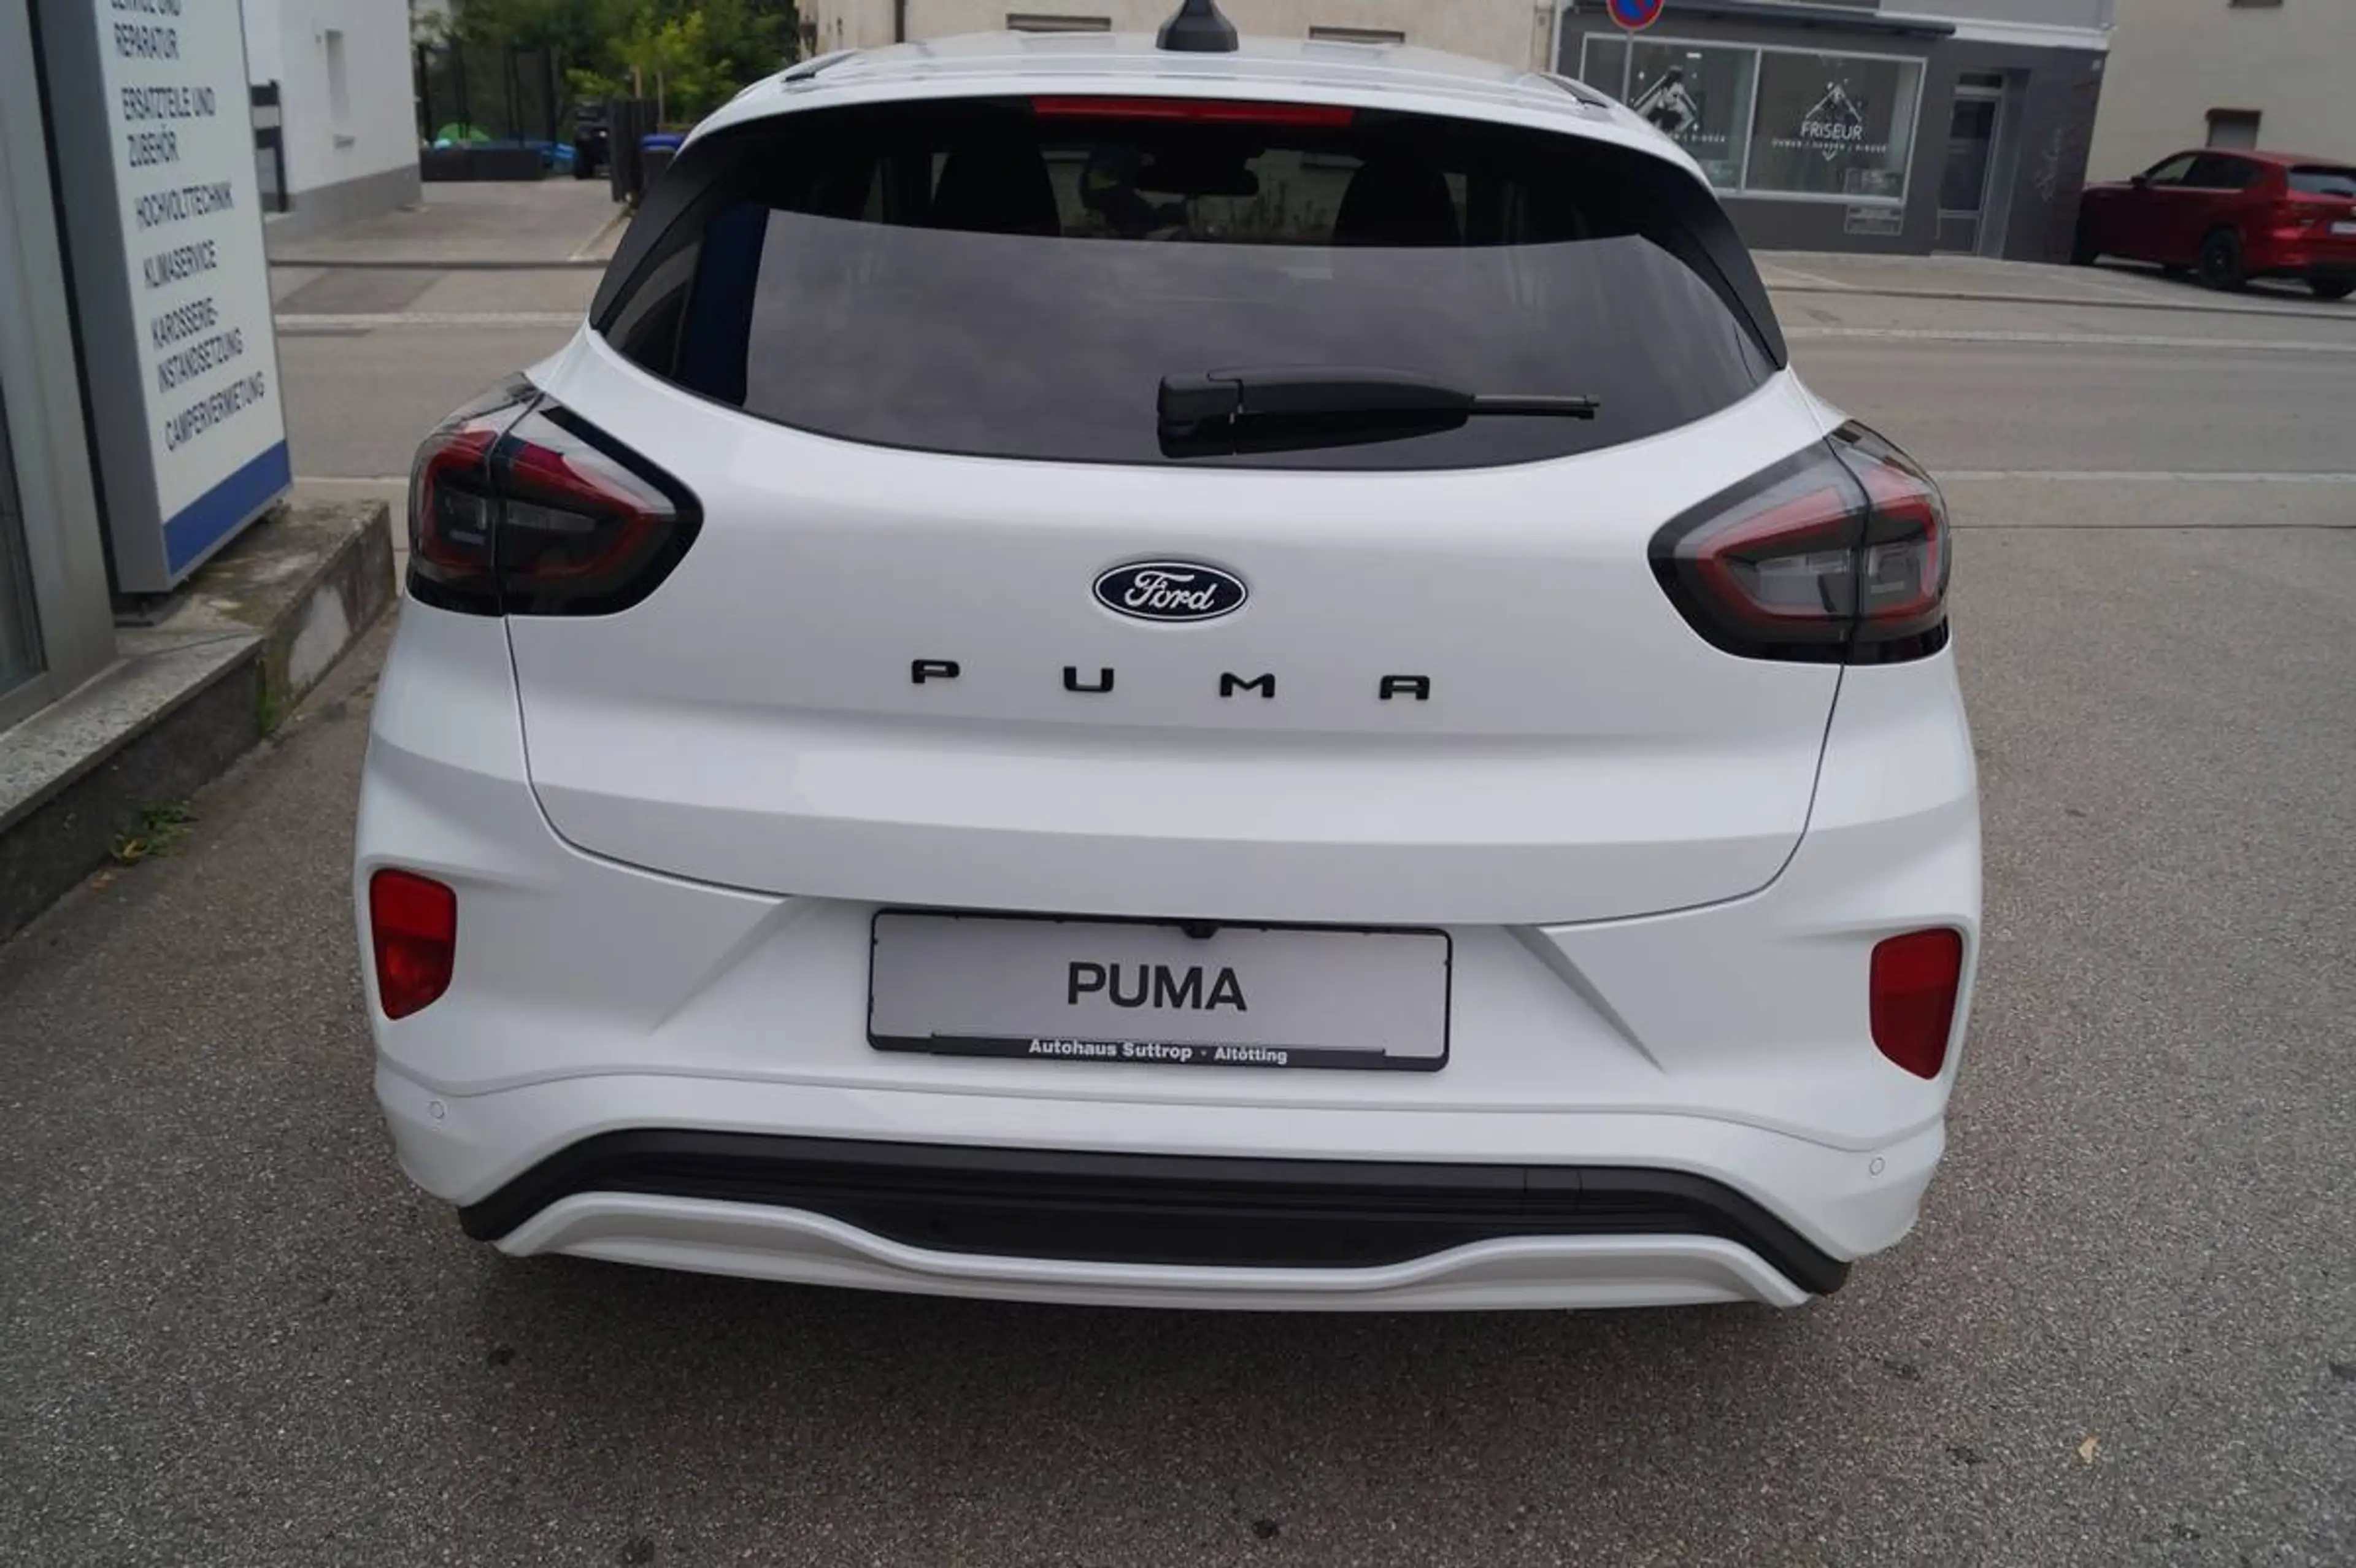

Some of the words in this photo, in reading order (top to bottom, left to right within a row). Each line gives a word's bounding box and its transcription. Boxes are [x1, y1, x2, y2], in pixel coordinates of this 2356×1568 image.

[114, 23, 180, 60] REPARATUR
[121, 87, 191, 120] ERSATZTEILE
[192, 87, 215, 117] UND
[128, 125, 179, 167] ZUBEHÖR
[1800, 121, 1863, 140] FRISEUR
[135, 182, 234, 231] HOCHVOLTTECHNIK
[144, 239, 217, 289] KLIMASERVICE
[158, 326, 244, 393] INSTANDSETZUNG
[165, 371, 264, 451] CAMPERVERMIETUNG
[1125, 571, 1218, 610] Ford
[912, 659, 1430, 701] PUMA
[1068, 961, 1247, 1012] PUMA
[1029, 1039, 1117, 1056] Autohaus
[1122, 1042, 1193, 1062] Suttrop
